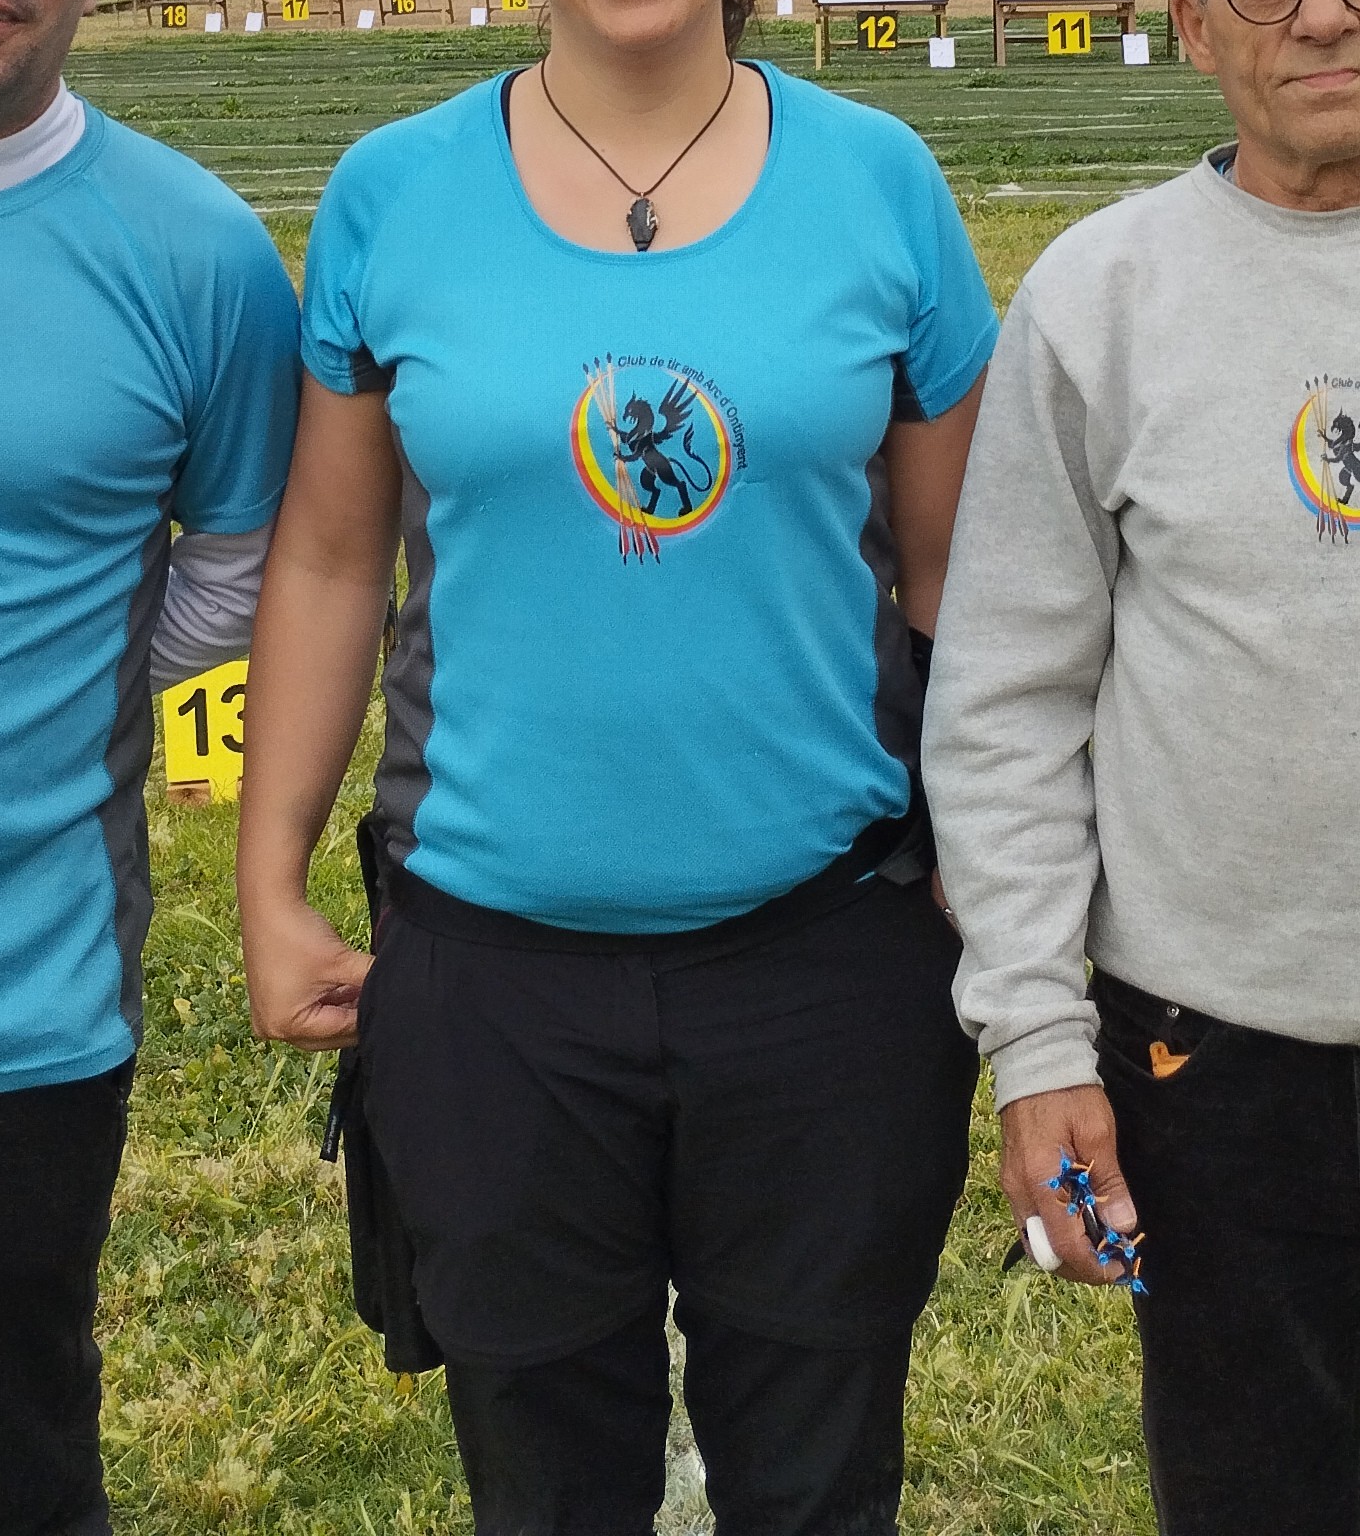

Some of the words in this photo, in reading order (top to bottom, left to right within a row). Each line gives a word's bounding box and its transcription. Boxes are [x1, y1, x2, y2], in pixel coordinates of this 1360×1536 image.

[163, 4, 187, 27] 18
[859, 15, 897, 49] 12
[1051, 17, 1086, 50] 11
[618, 354, 647, 368] Club
[650, 355, 665, 367] de
[667, 357, 681, 372] tir
[682, 365, 705, 382] amb
[703, 378, 723, 398] Arc
[1331, 377, 1354, 388] Club
